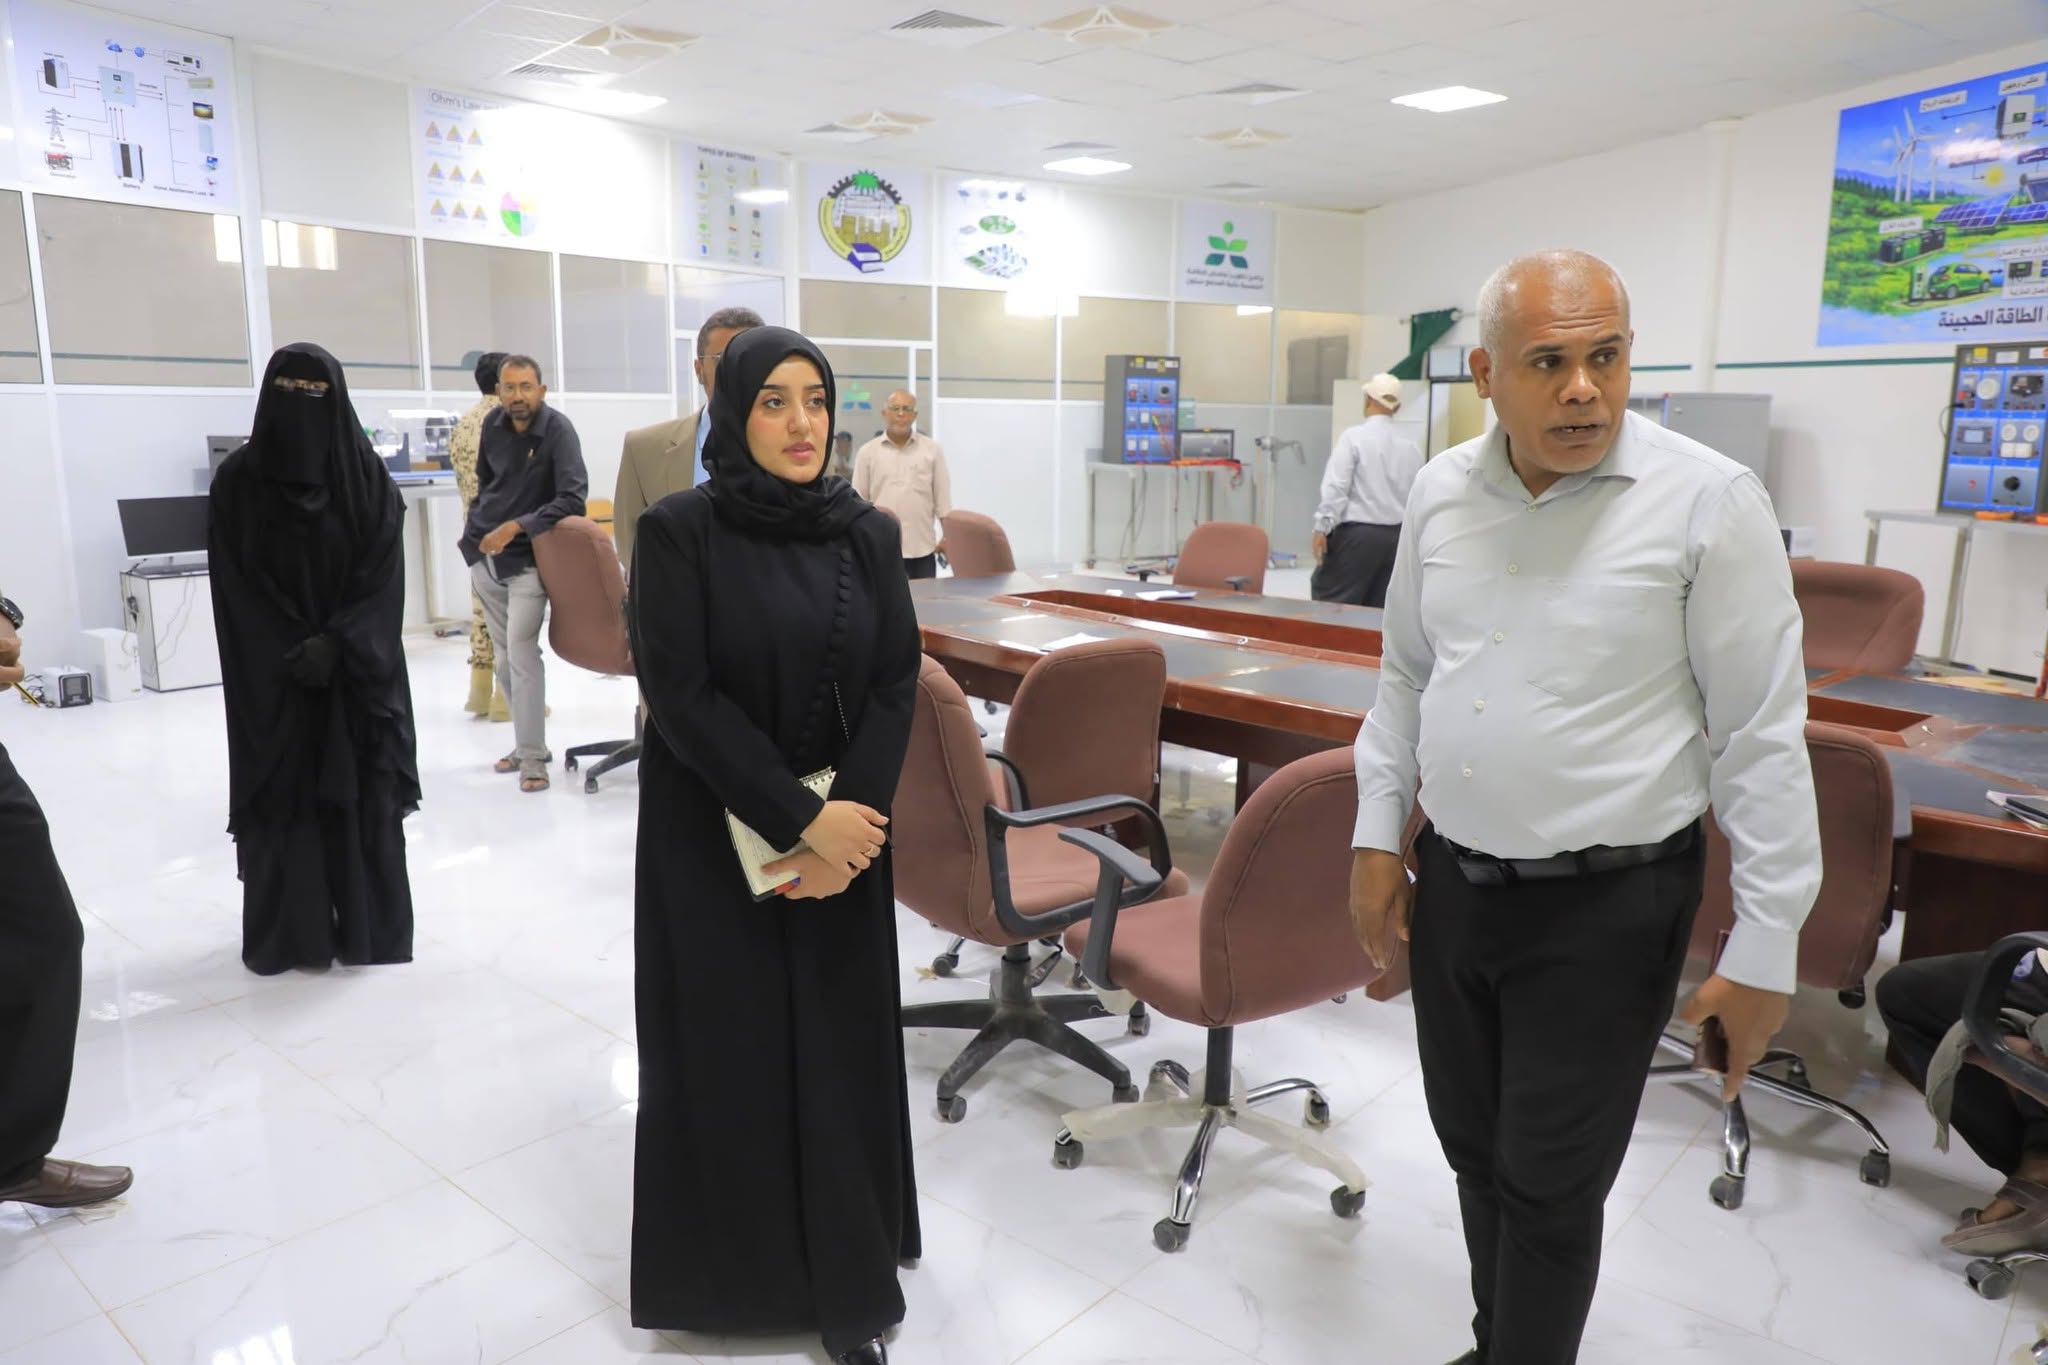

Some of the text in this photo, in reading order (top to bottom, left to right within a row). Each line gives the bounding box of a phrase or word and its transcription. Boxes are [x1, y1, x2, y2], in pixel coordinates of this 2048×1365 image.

[432, 92, 461, 108] Ohm's
[1938, 306, 2043, 332] الطاقة الهجينة
